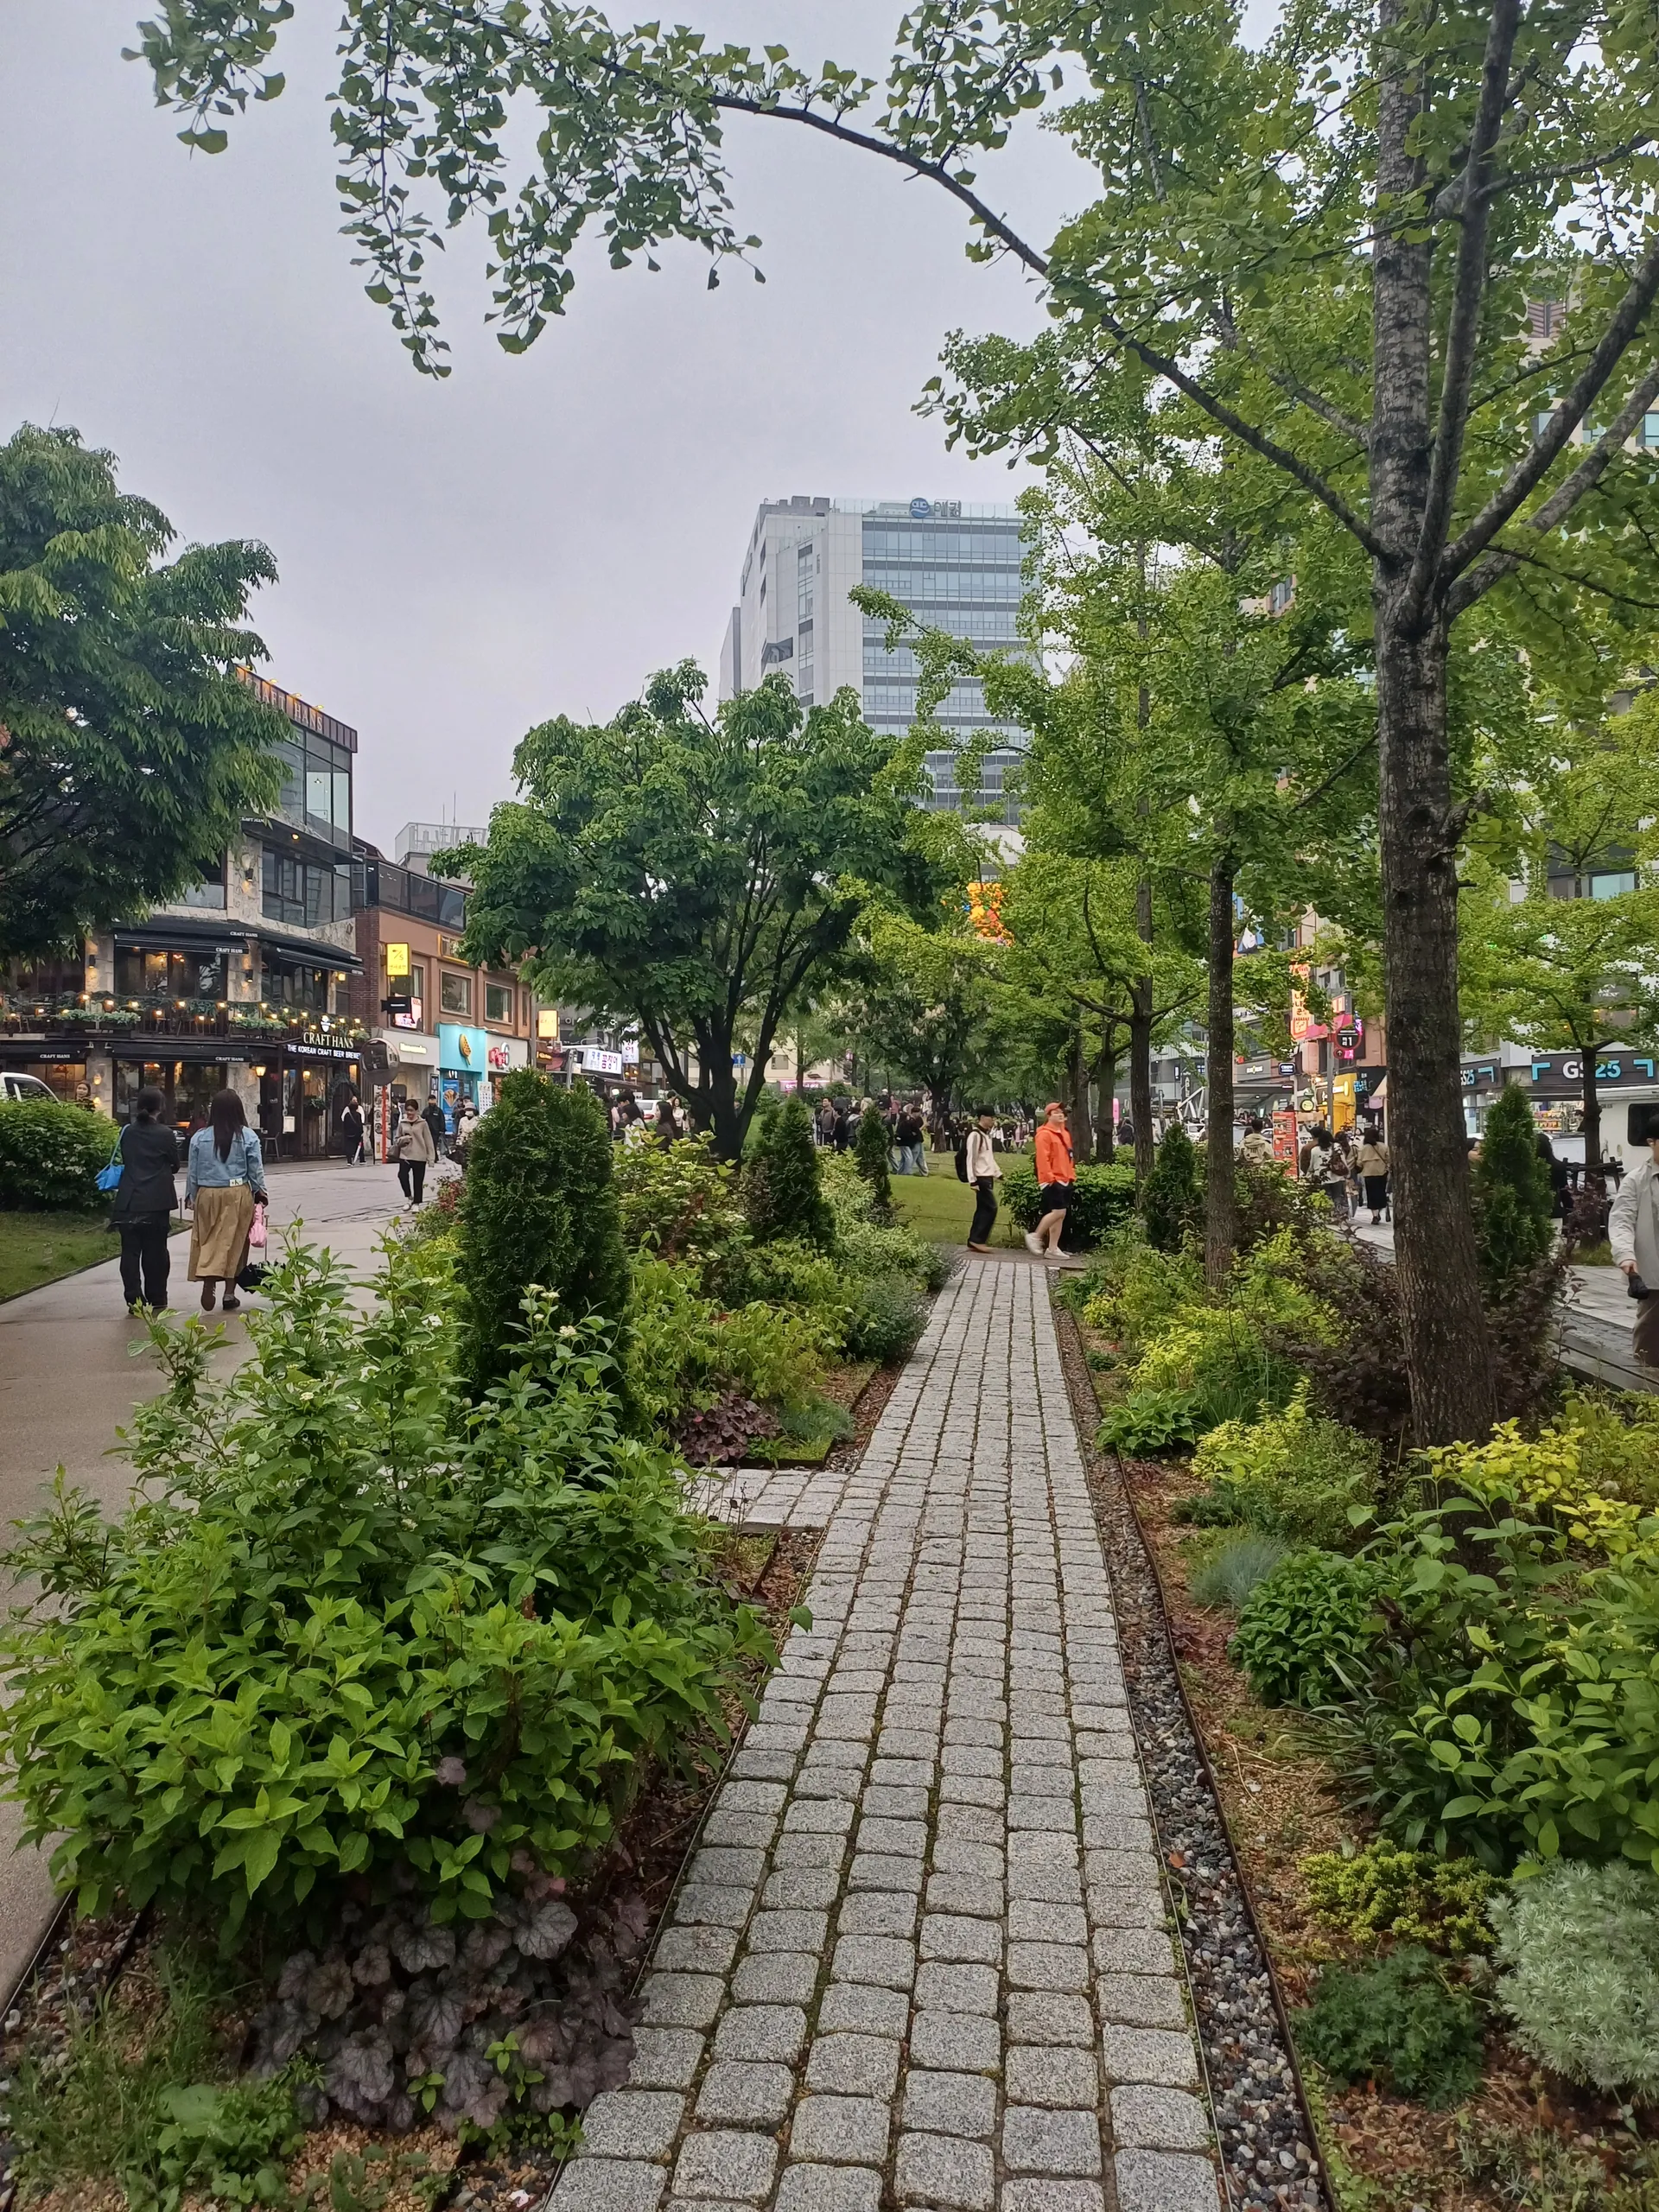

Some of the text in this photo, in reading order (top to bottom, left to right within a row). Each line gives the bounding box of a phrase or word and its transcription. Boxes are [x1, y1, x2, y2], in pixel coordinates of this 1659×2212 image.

[245, 677, 323, 732] CRAFT HANS
[302, 1032, 353, 1049] CRAFT HANS
[287, 1044, 297, 1053] THE
[297, 1046, 316, 1055] KOREAN
[317, 1048, 333, 1057] CRAFT
